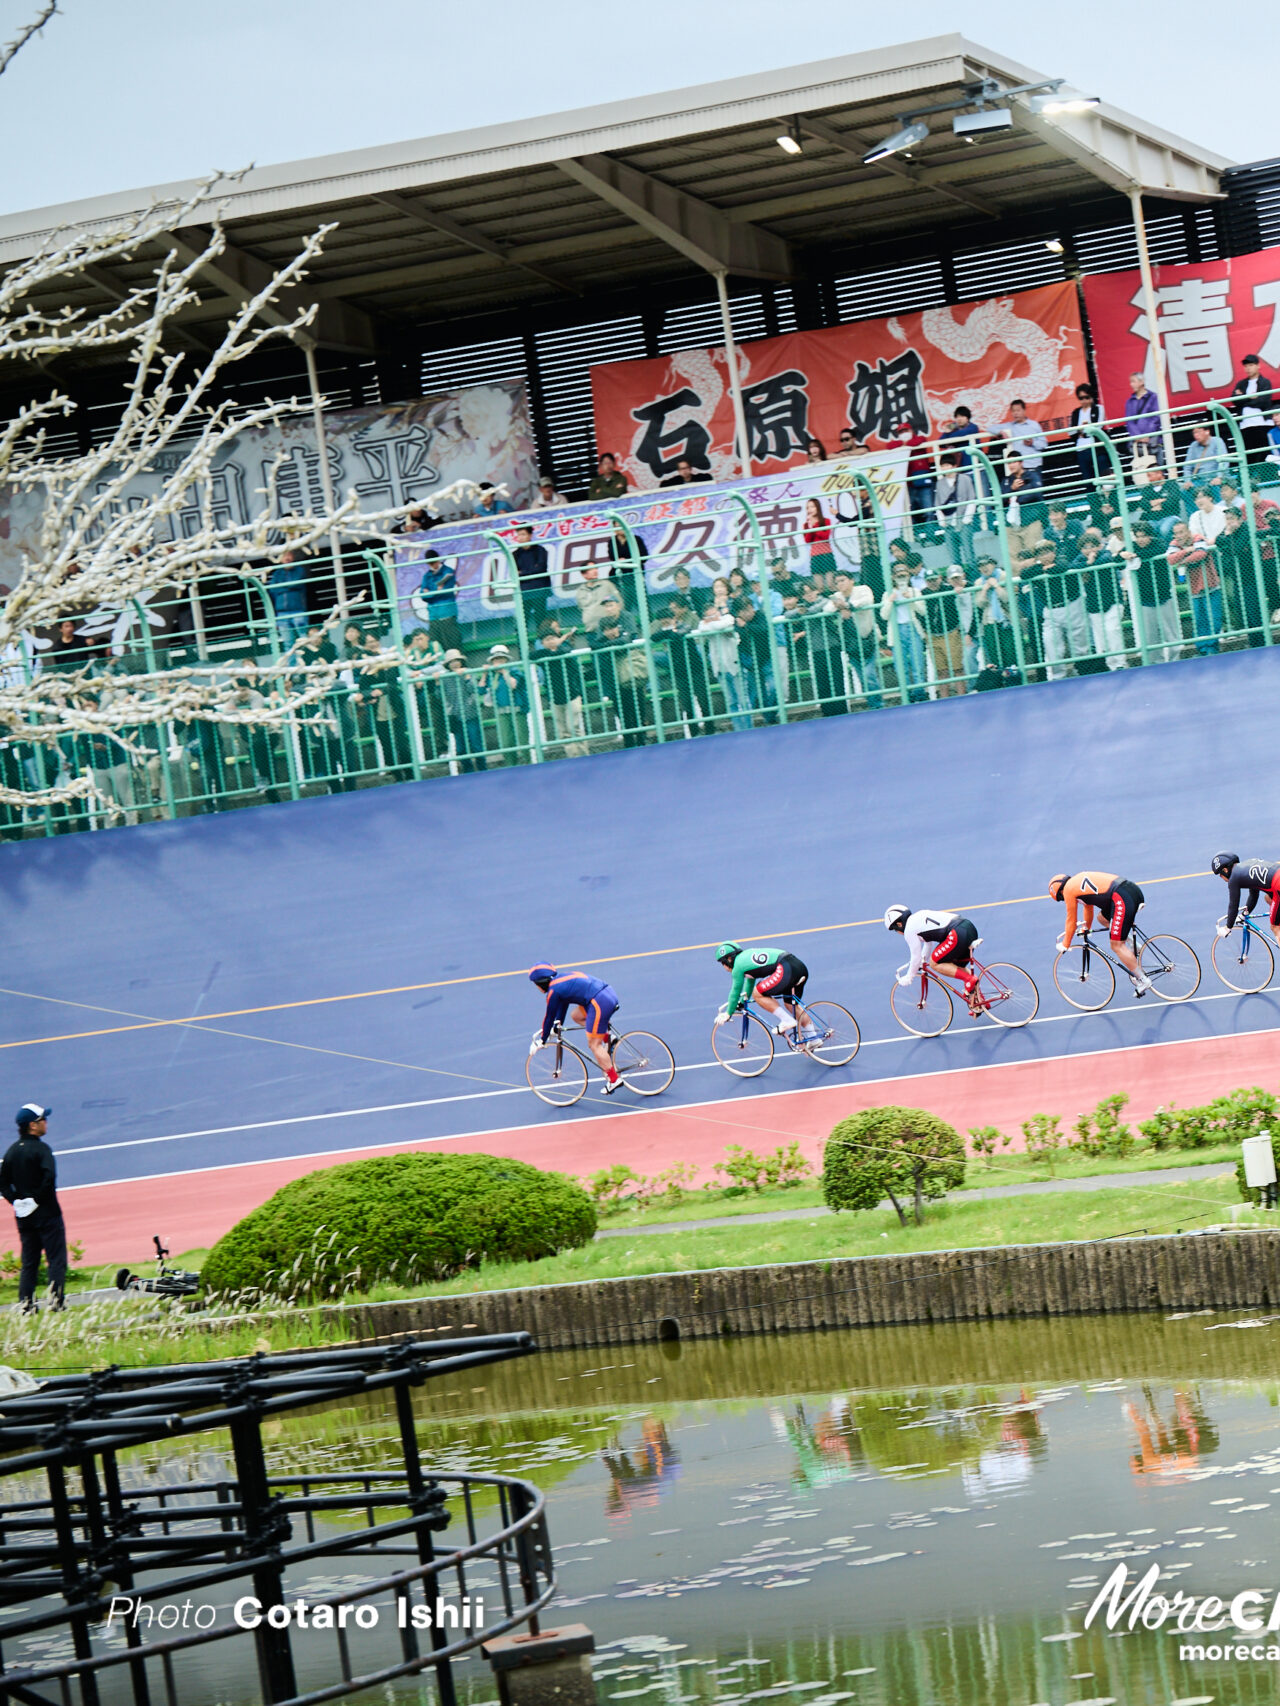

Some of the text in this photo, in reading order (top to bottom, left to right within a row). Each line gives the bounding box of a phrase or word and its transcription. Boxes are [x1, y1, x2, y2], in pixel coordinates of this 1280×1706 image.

[631, 348, 931, 478] 石原颯
[1248, 864, 1269, 885] 2
[1080, 875, 1100, 895] 7
[925, 916, 941, 926] 1
[752, 952, 769, 966] 6
